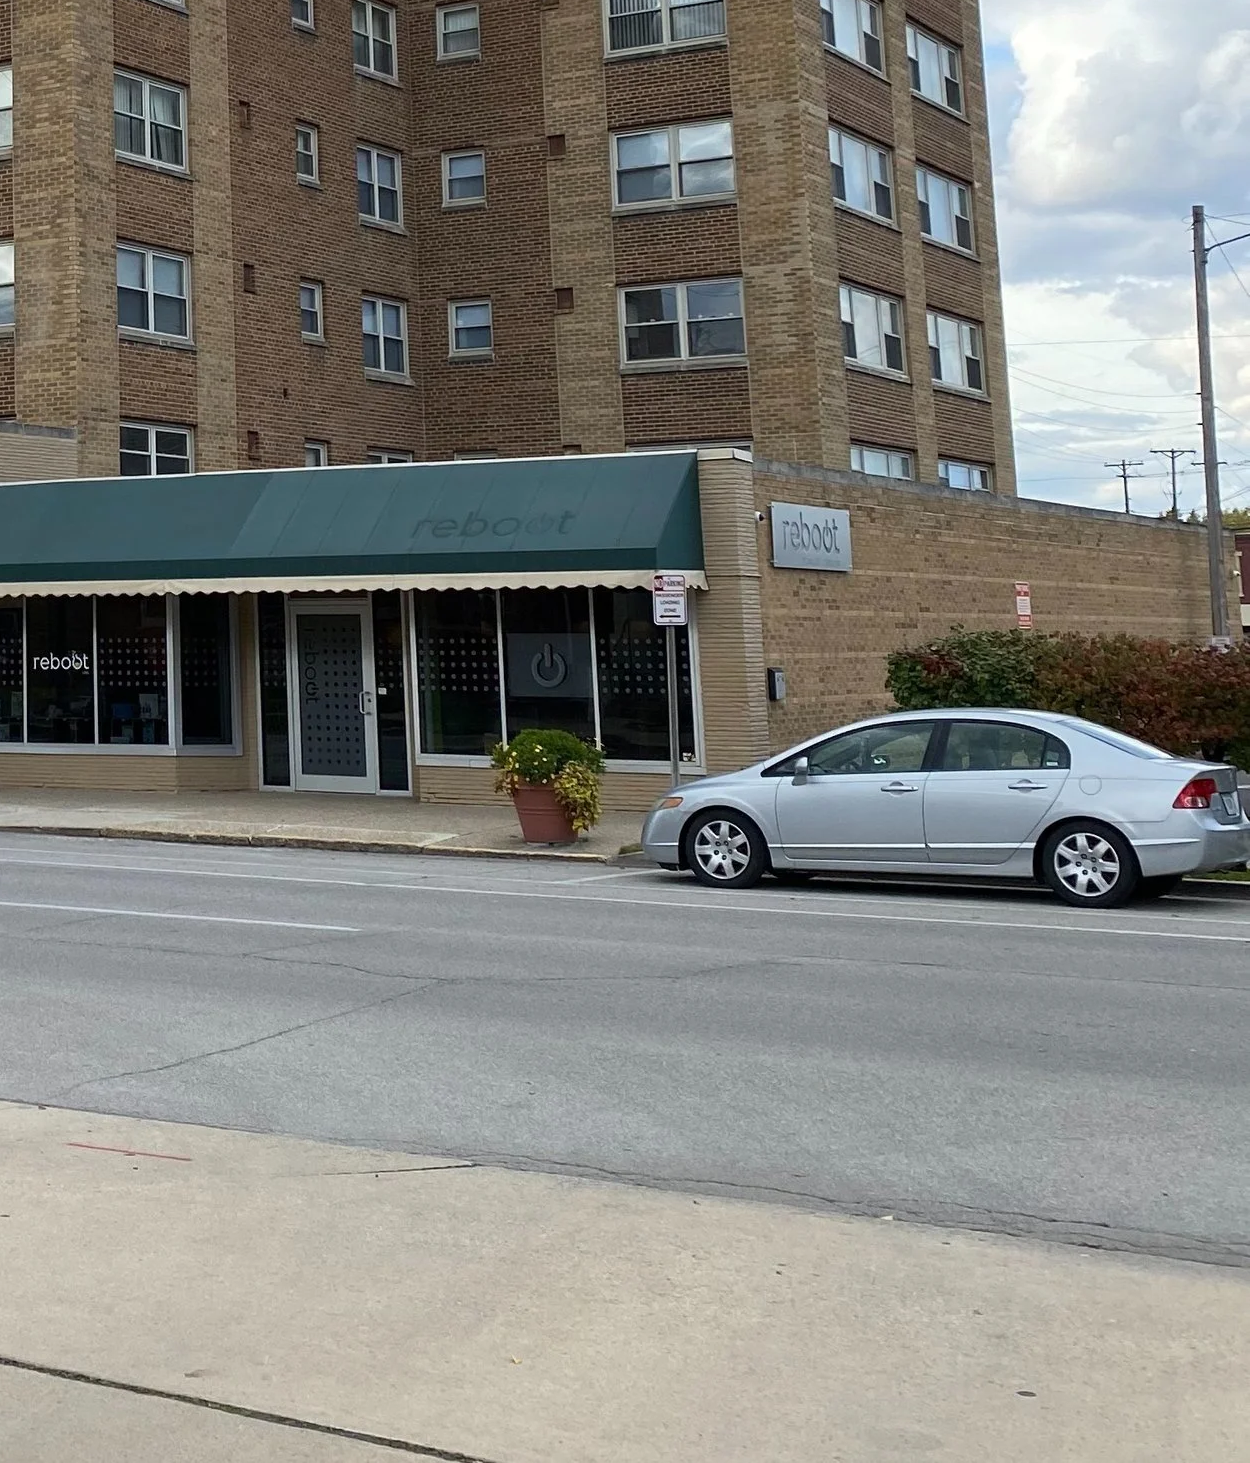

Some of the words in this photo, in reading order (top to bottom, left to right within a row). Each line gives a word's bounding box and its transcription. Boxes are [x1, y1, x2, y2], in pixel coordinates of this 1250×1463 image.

[411, 510, 576, 538] reboot
[782, 511, 840, 553] reboot
[33, 650, 90, 670] reboot
